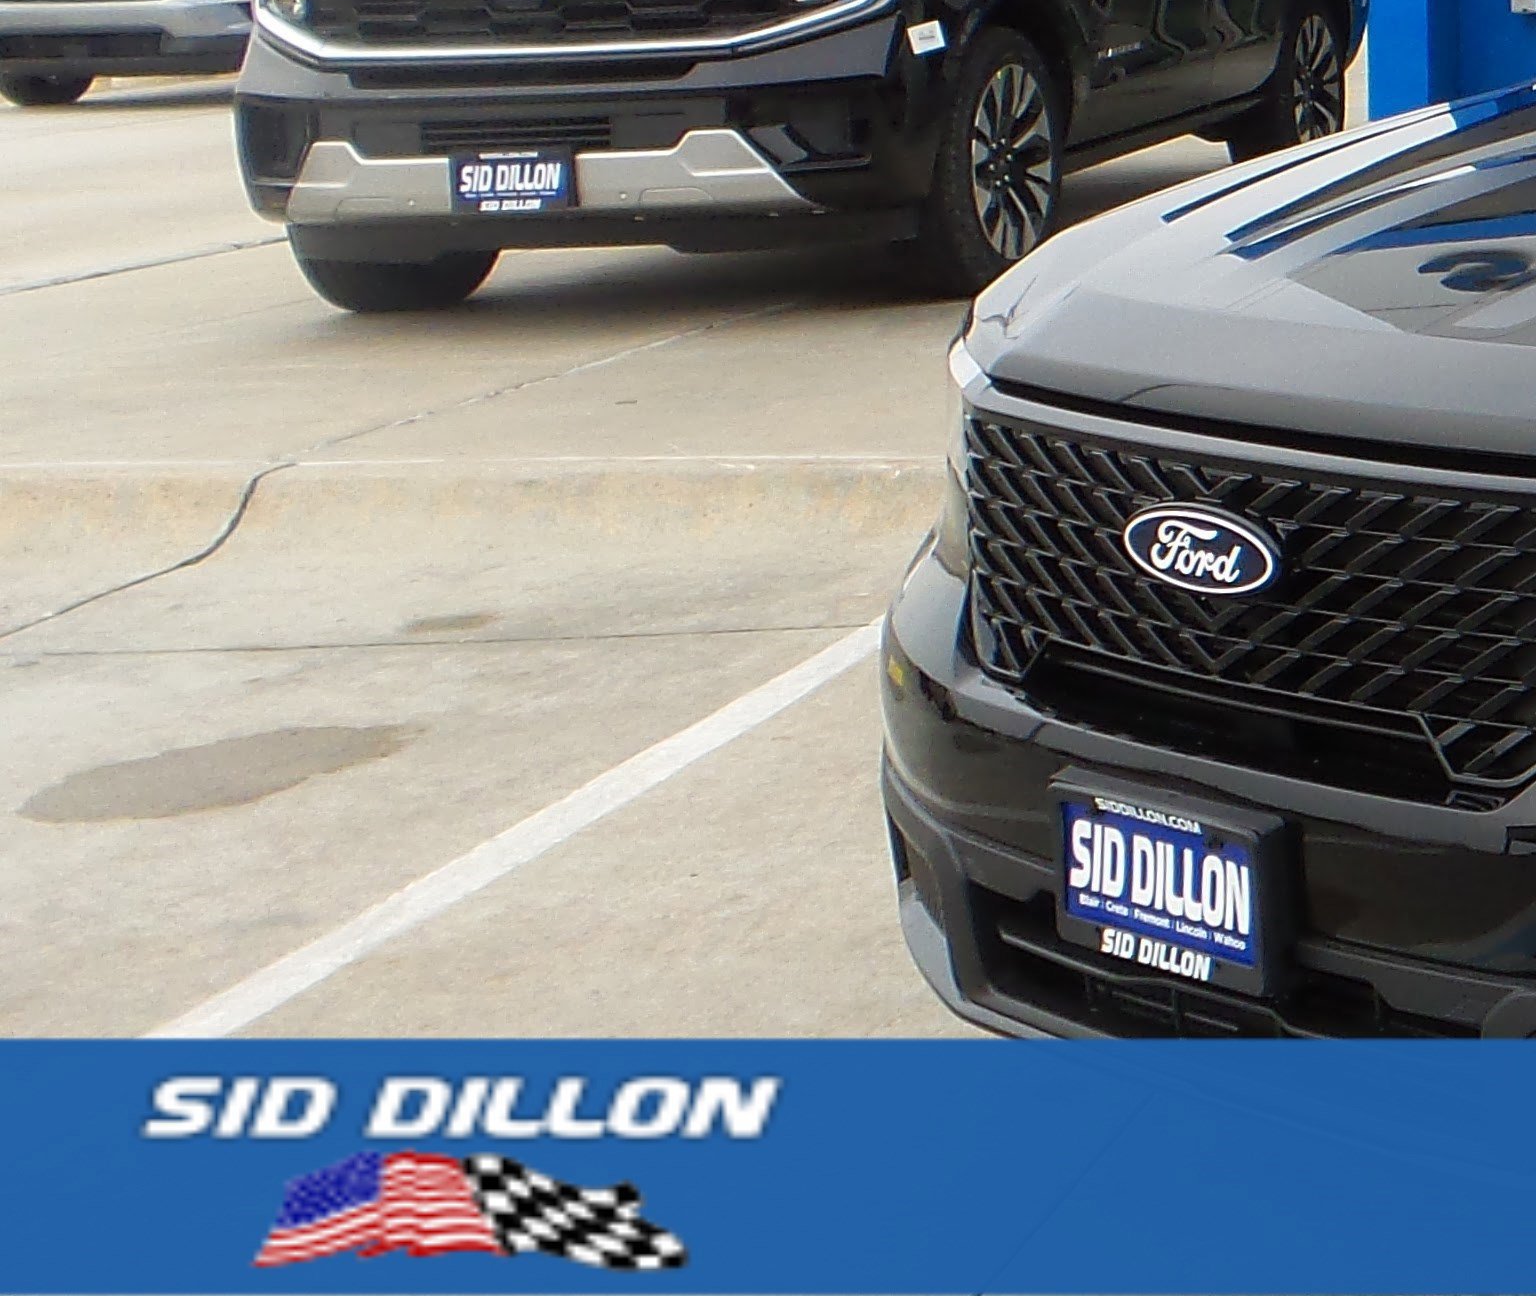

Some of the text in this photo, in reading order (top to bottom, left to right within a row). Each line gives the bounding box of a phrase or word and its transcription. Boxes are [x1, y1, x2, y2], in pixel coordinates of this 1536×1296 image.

[459, 162, 561, 193] SID DILLON
[1150, 518, 1242, 584] Ford
[1094, 796, 1203, 836] SIDDILLON.COM
[1069, 818, 1251, 936] SID DILLON
[1134, 908, 1171, 929] Fremont
[1175, 920, 1209, 940] Lincoln
[1213, 932, 1246, 951] Wahoo
[1101, 928, 1212, 982] SID DILLON
